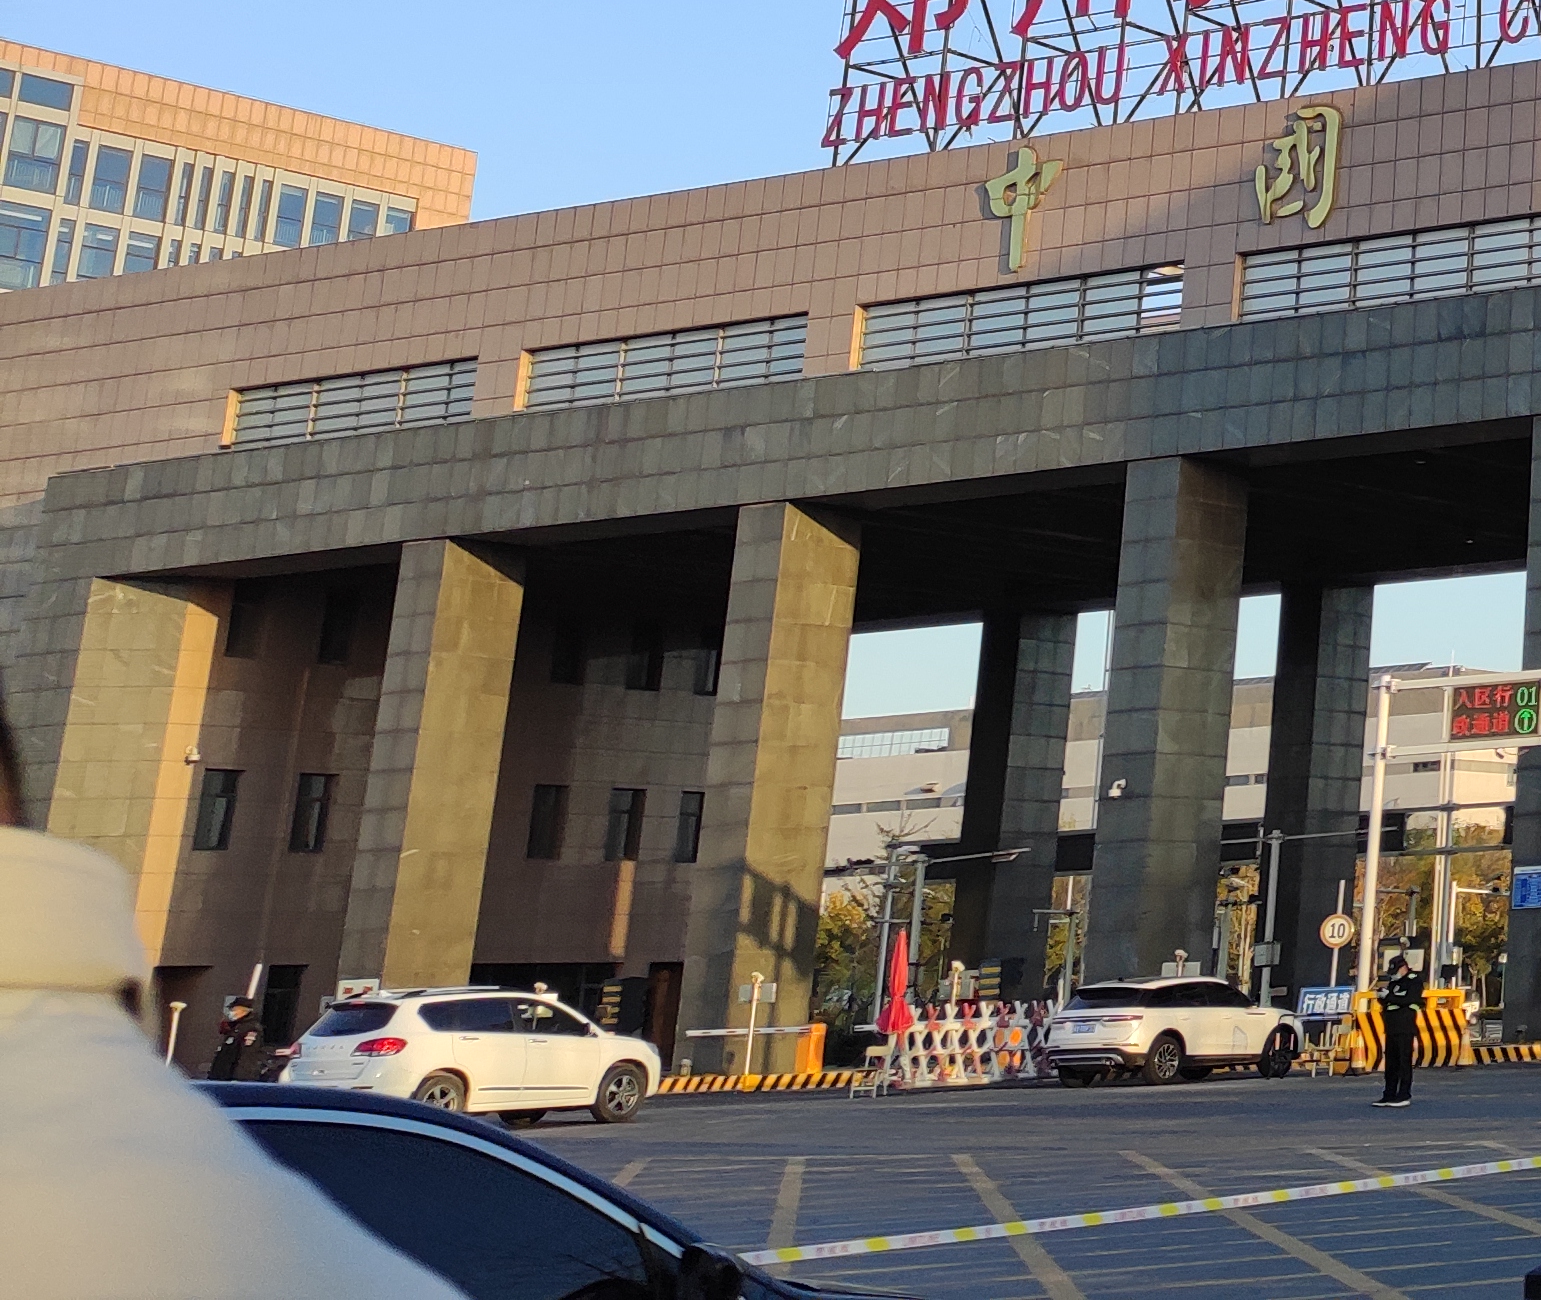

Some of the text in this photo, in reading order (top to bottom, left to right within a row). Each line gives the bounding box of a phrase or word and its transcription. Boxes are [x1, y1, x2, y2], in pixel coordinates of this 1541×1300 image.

[821, 43, 1128, 149] ZHENGZHOU
[1516, 687, 1538, 707] 01
[1328, 922, 1346, 939] 10
